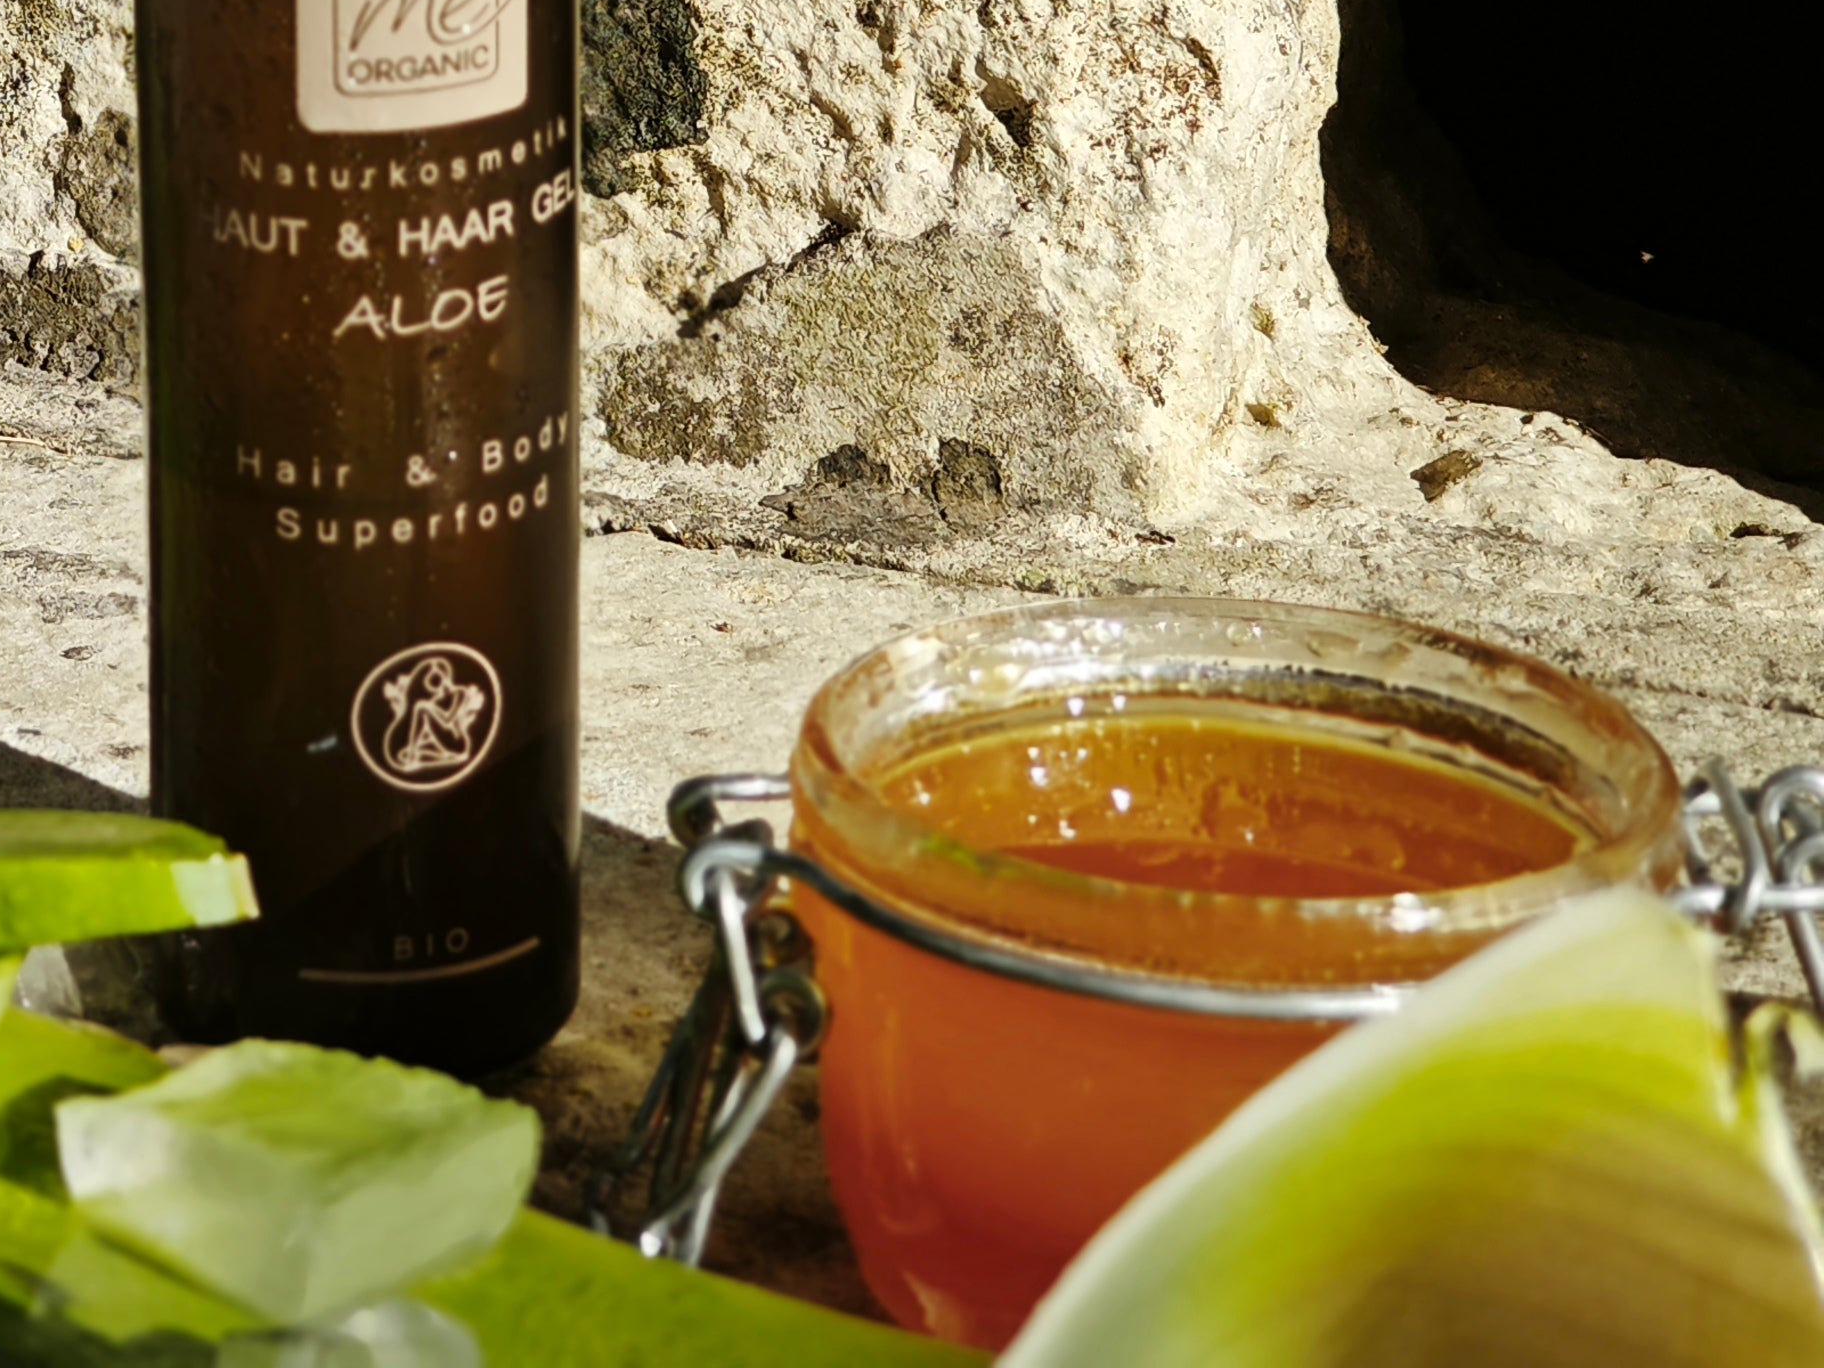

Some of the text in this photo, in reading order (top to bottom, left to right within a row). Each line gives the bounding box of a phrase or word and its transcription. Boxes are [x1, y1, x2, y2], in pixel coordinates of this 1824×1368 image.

[347, 44, 489, 85] ORGANIC
[239, 114, 567, 190] Naturkosmetik
[336, 220, 368, 259] &
[398, 199, 514, 258] HAAR
[531, 167, 575, 225] GEL
[333, 273, 509, 341] ALOE
[236, 410, 568, 489] Hair & Body
[276, 474, 548, 551] Superfood
[393, 927, 470, 961] BIO
